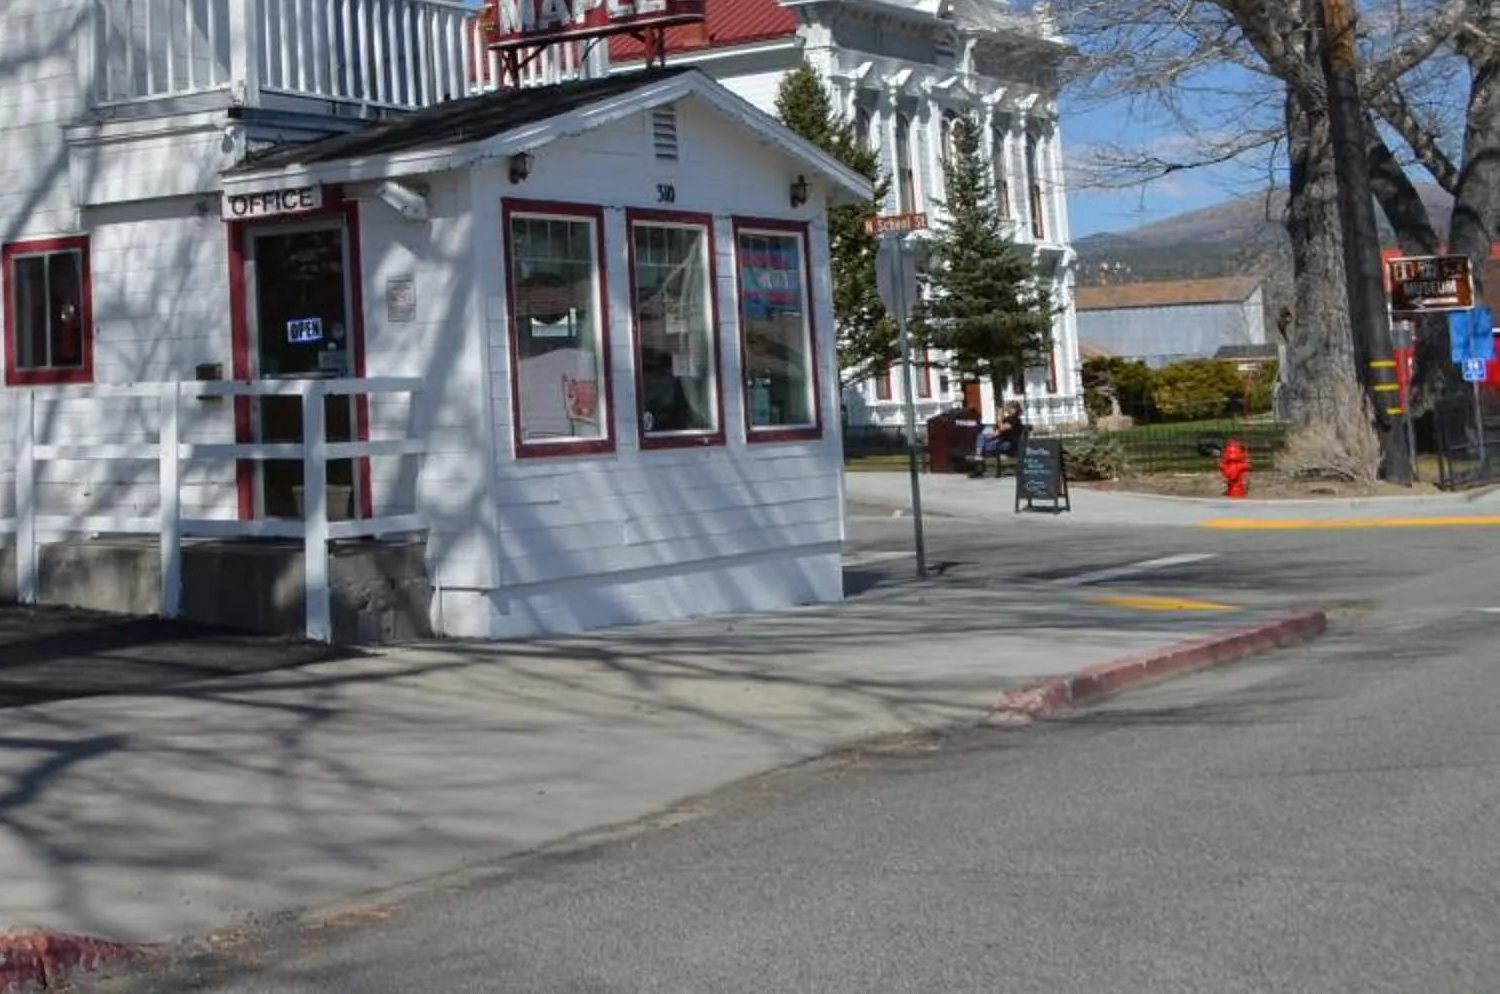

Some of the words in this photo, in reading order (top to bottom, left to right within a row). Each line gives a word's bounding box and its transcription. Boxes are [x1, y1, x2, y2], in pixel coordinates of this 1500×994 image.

[229, 187, 314, 215] OFFICE
[865, 220, 873, 233] N
[877, 216, 911, 233] School
[1404, 278, 1457, 295] MUSEUM
